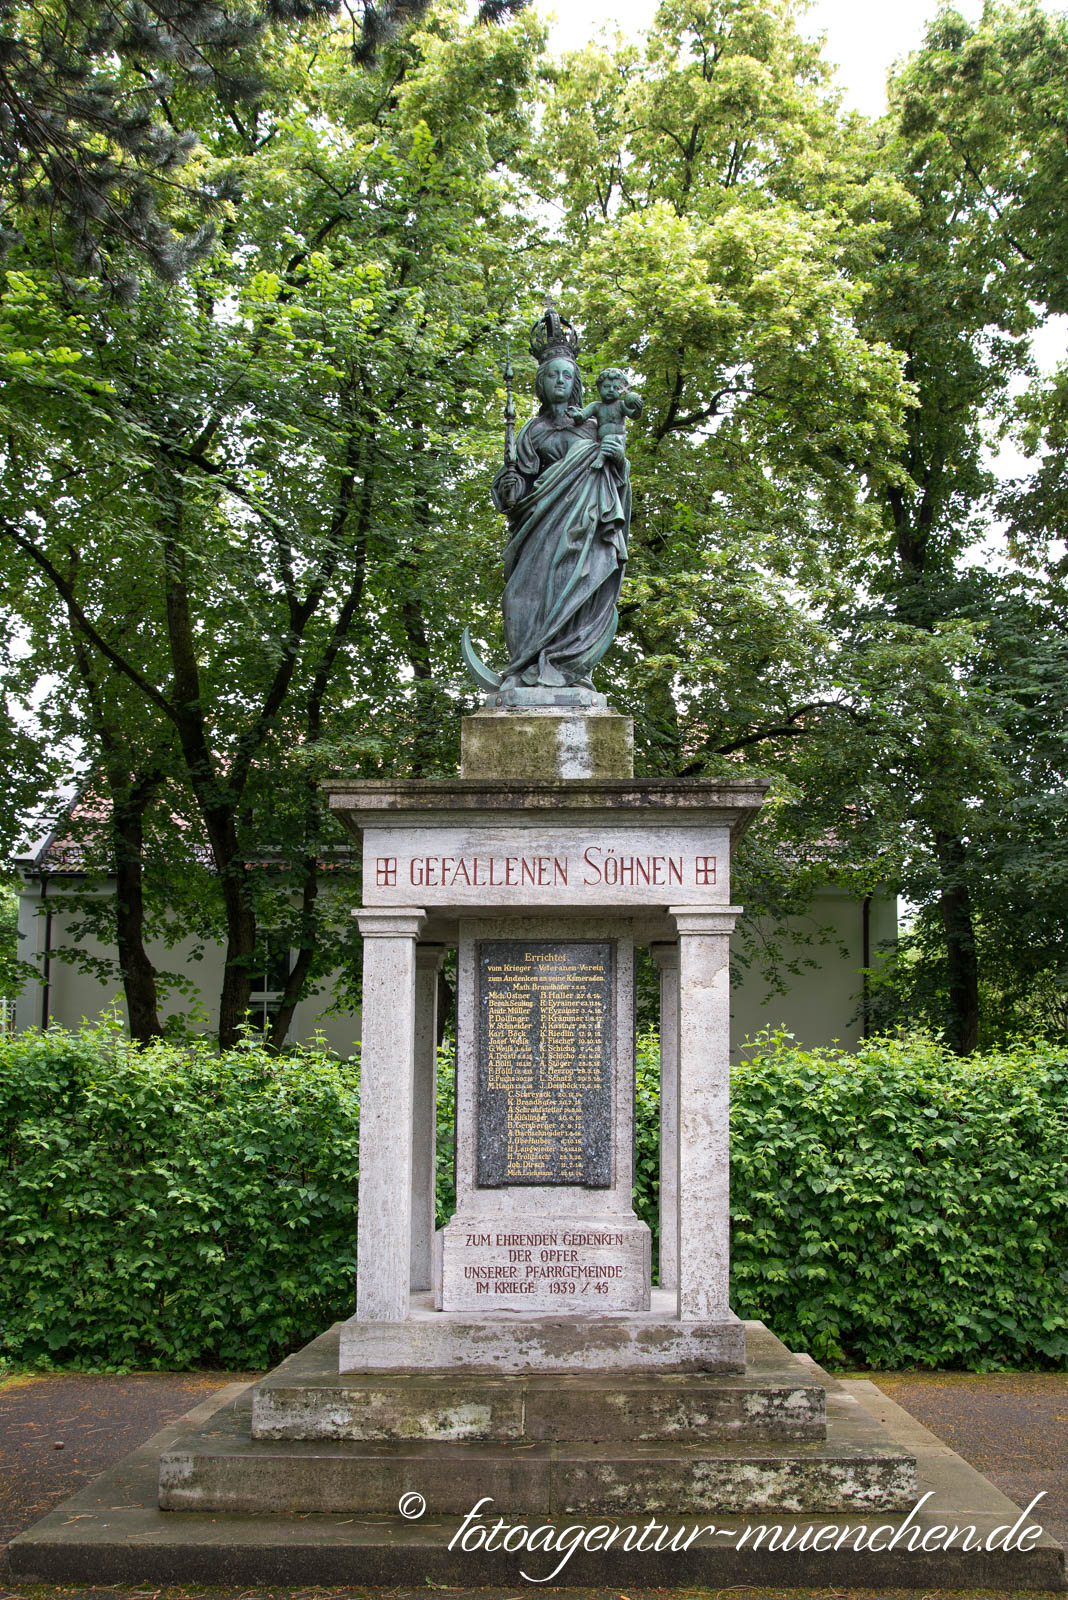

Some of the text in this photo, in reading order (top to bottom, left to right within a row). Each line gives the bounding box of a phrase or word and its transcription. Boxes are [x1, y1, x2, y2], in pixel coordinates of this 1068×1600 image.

[410, 846, 683, 886] GEFALLENEN SÖHNEN
[525, 952, 567, 962] Errichtet
[465, 1234, 623, 1246] ZUM EHRENDEN GEDENKEN
[508, 1250, 579, 1262] DER OPFER
[464, 1266, 622, 1278] UNSERER PFARRGEMEINDE
[476, 1282, 489, 1294] IM
[494, 1282, 535, 1294] KRIEGE
[549, 1282, 576, 1294] 1939
[594, 1282, 609, 1294] 45
